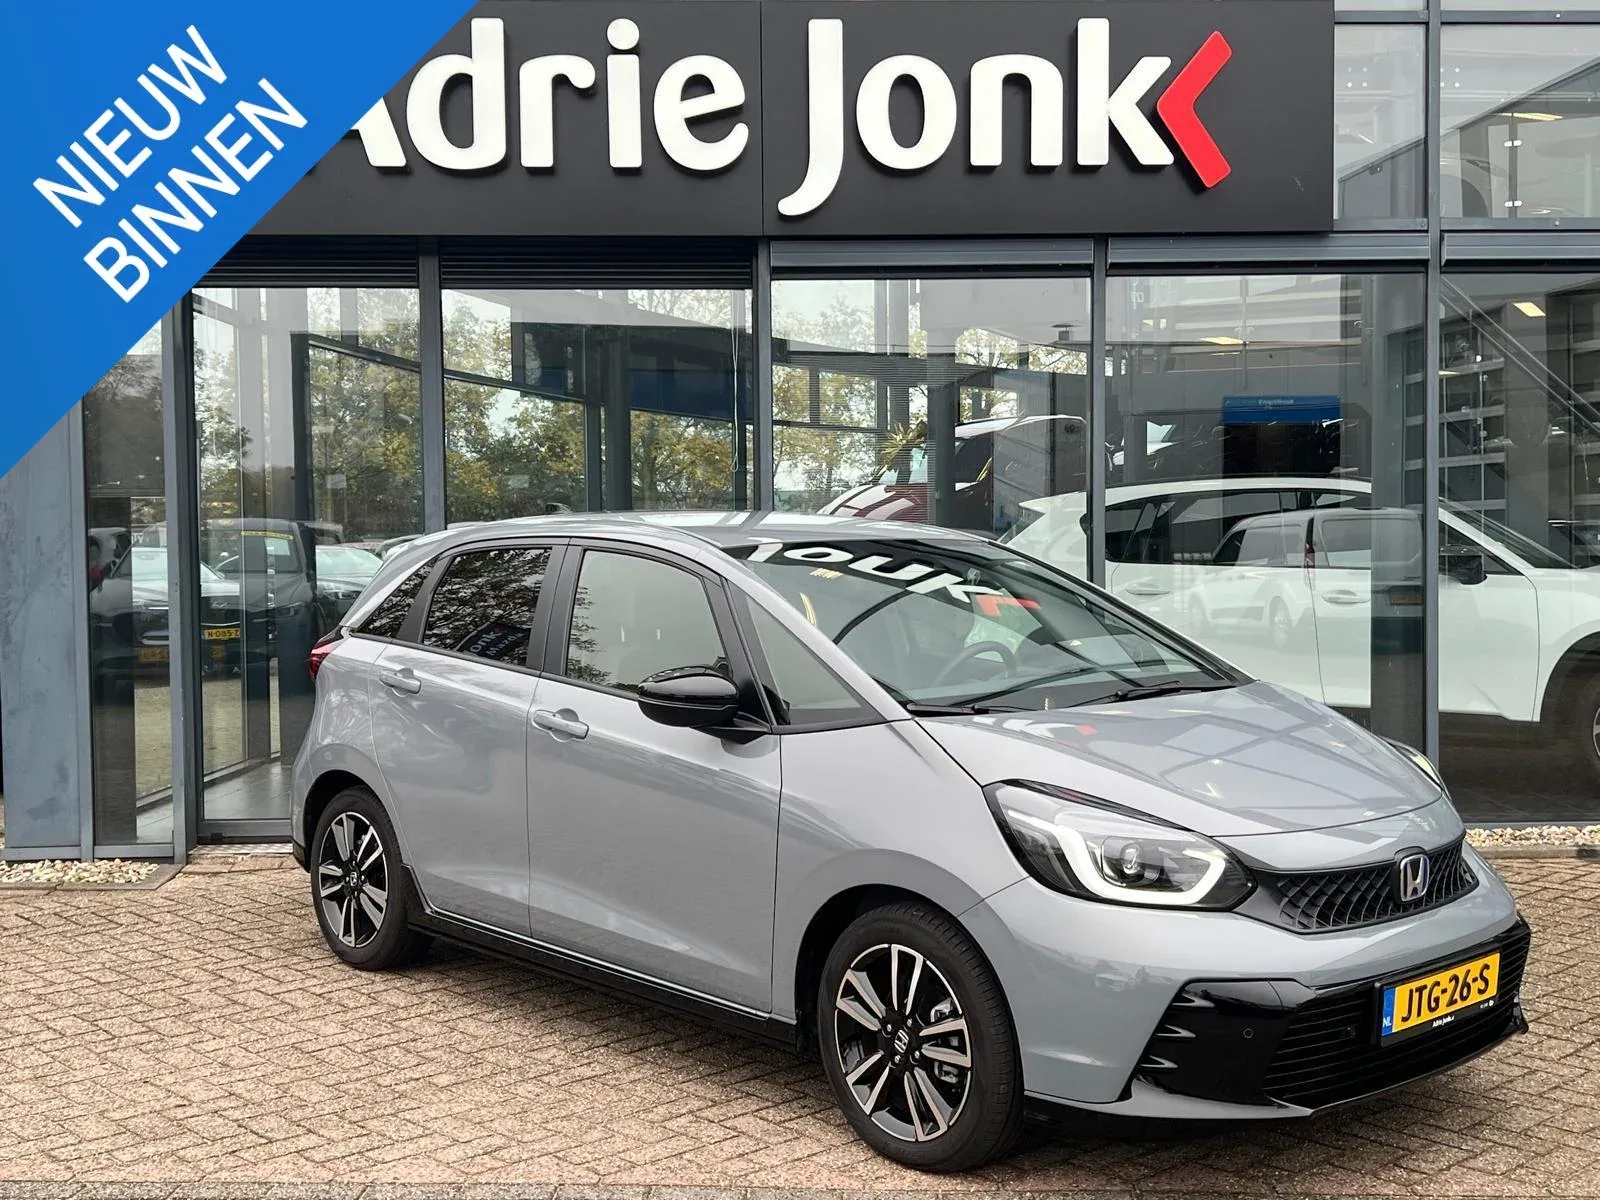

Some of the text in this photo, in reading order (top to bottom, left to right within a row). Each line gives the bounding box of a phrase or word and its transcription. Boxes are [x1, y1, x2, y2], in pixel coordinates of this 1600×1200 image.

[777, 18, 1175, 217] Jonk
[1382, 1015, 1392, 1028] NL
[1401, 963, 1490, 1022] JTG-26-S
